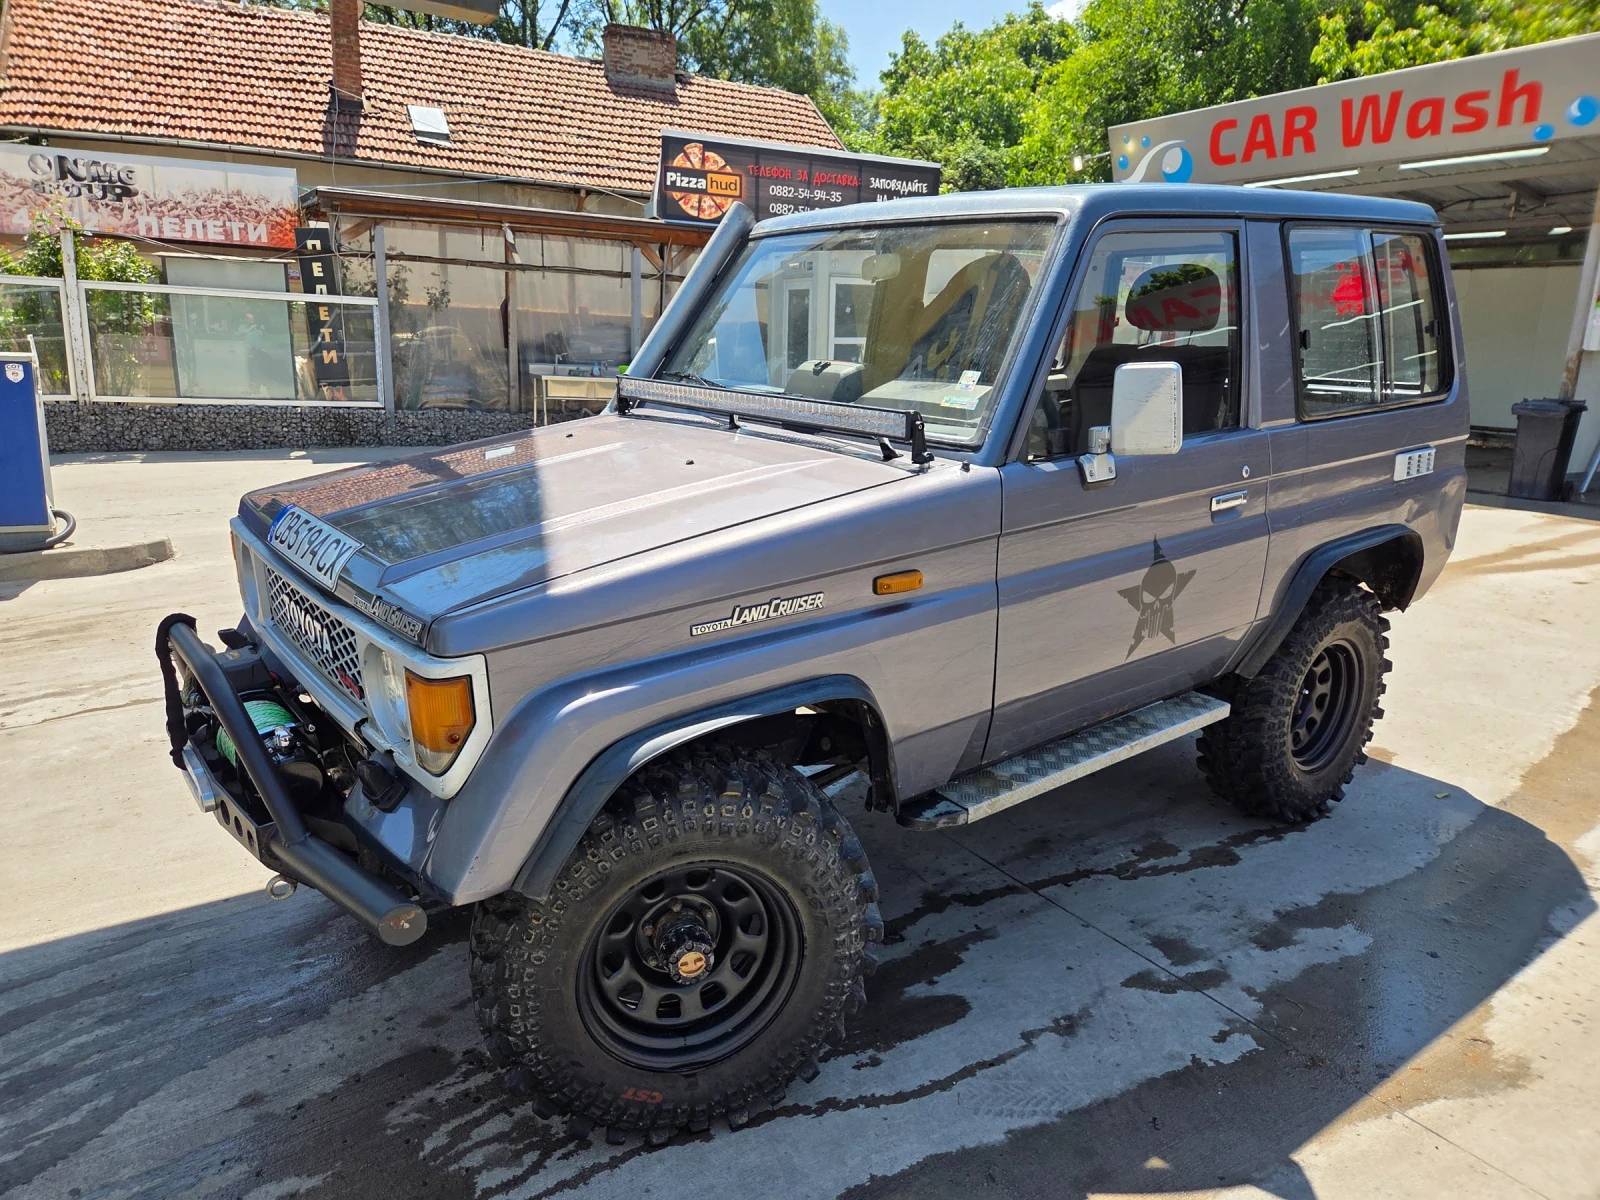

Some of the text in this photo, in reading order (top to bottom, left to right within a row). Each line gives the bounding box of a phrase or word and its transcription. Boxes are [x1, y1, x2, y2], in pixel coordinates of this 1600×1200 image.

[1209, 68, 1543, 166] CAR Wash
[666, 171, 738, 192] Pizza hud
[747, 164, 862, 187] ТЕЛЕФОН ЗА ДОСТАВКА:
[869, 176, 928, 195] ЗАПОВЯДАЙТЕ
[769, 185, 842, 202] 0882-54-94-35
[137, 215, 268, 243] ПЕЛЕТИ
[306, 239, 338, 364] ПЕЛЕТИ
[282, 593, 333, 659] TOYOTA
[695, 620, 729, 634] TOYOTA
[619, 1087, 663, 1104] CST
